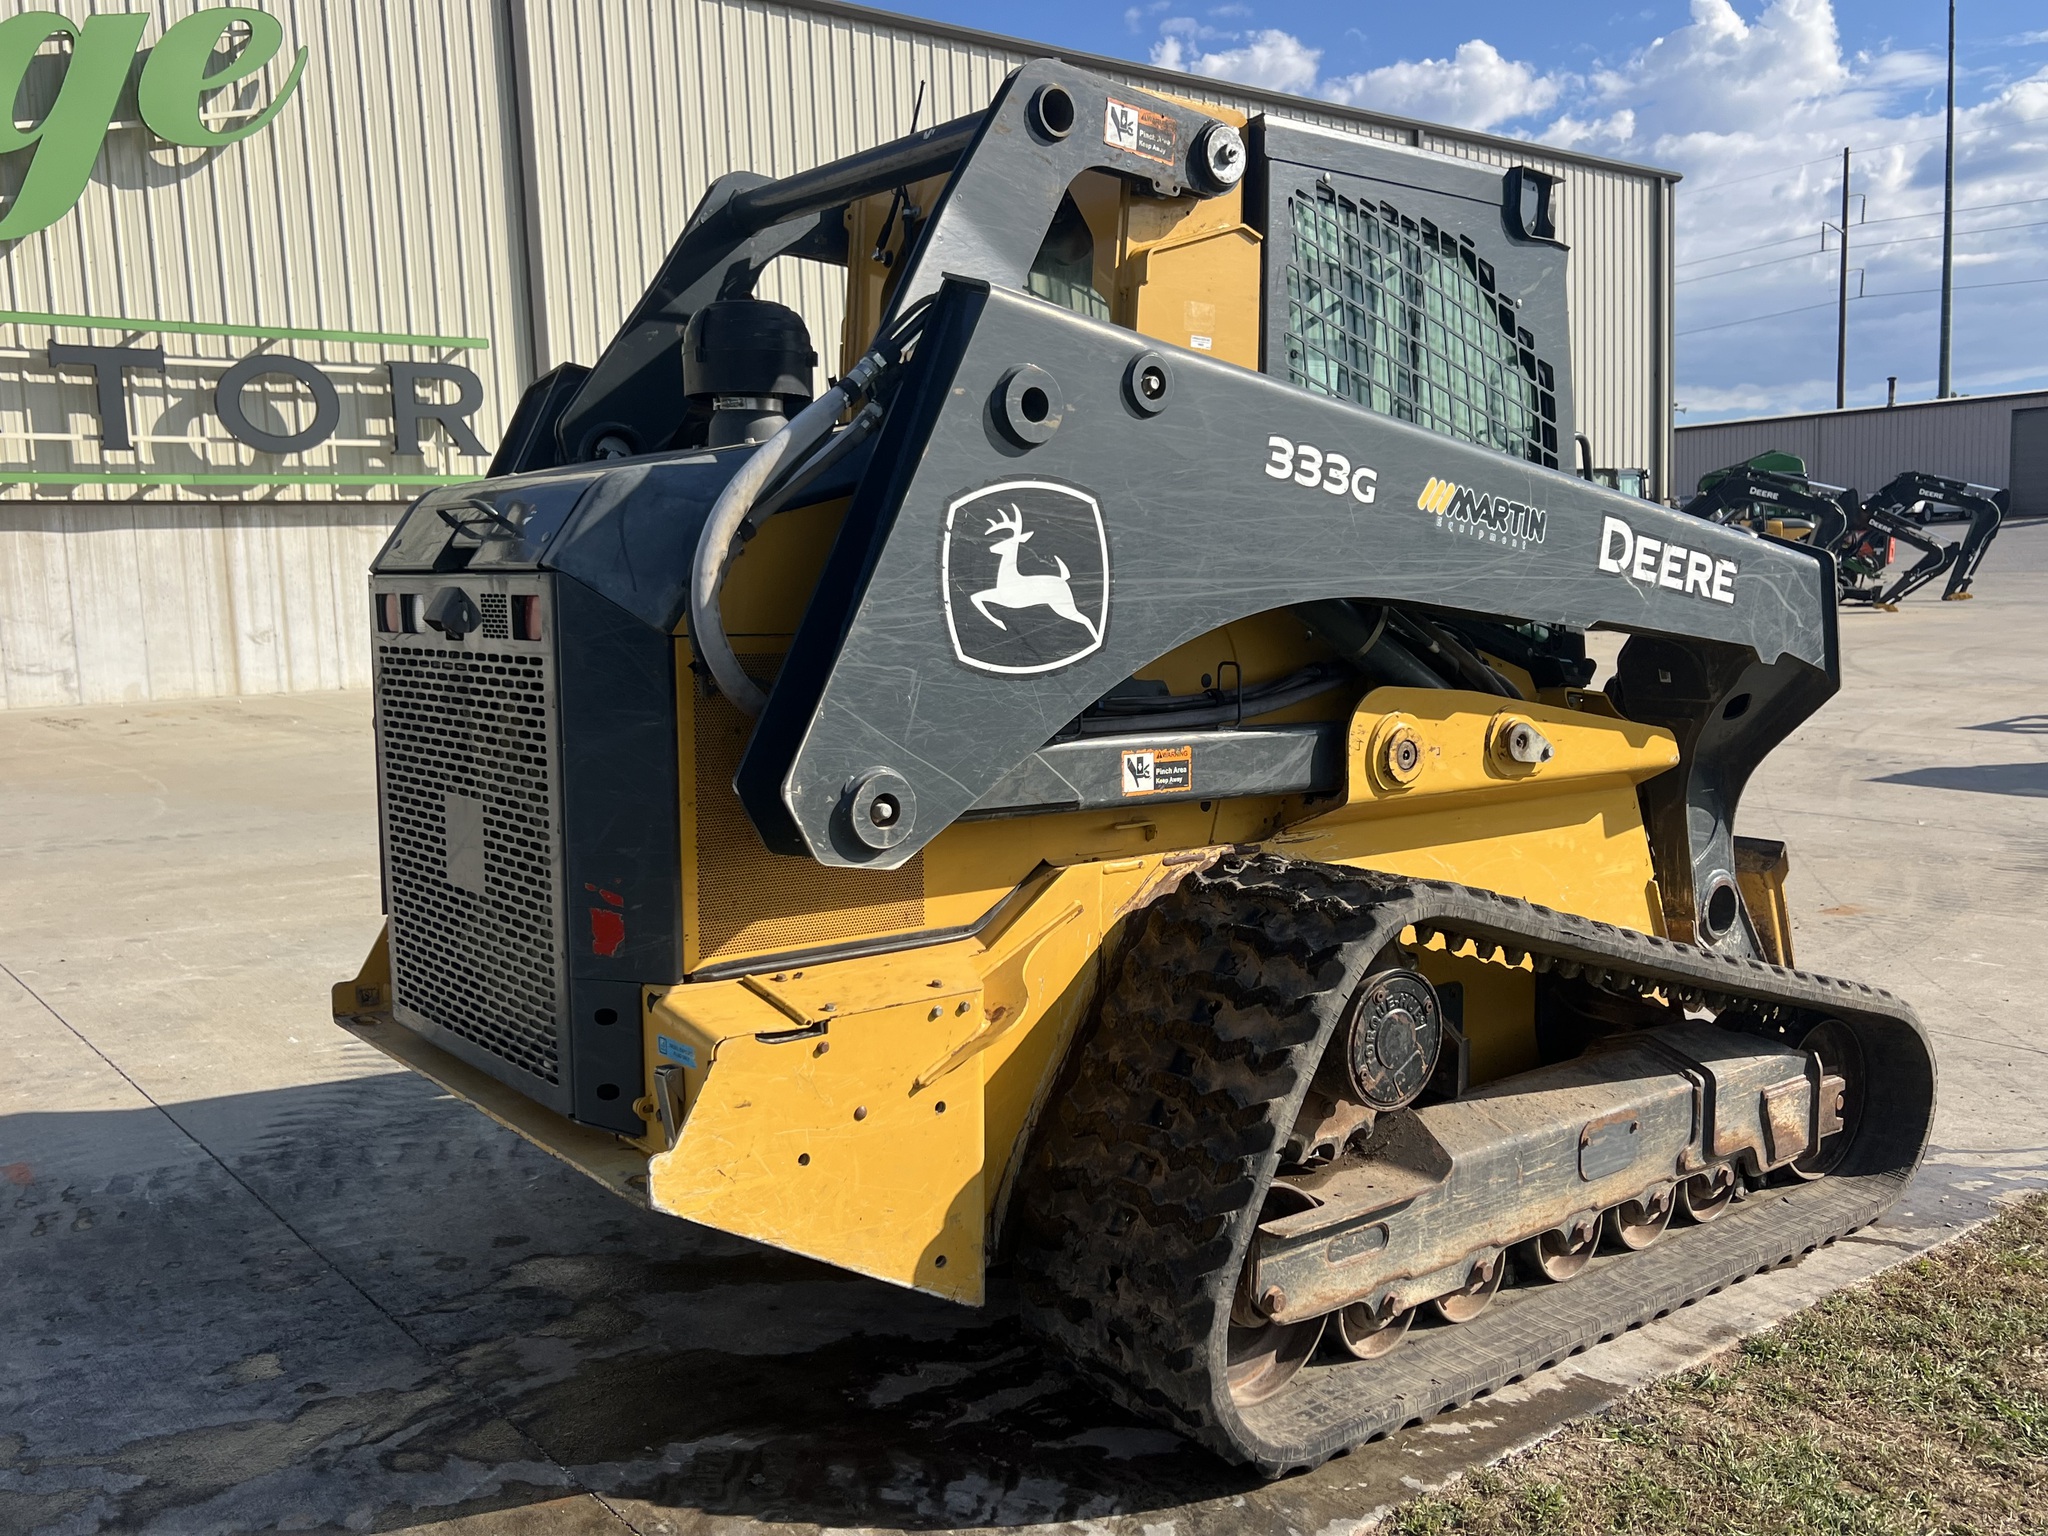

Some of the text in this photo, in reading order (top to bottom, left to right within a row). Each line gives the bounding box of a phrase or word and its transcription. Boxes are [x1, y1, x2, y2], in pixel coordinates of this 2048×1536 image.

[48, 338, 491, 457] TOR
[1264, 435, 1379, 504] 333G
[1749, 486, 1779, 500] DEERE
[1918, 488, 1944, 500] DEERE
[1446, 485, 1547, 543] MARTIN
[1868, 518, 1893, 534] DEERE
[1436, 516, 1526, 550] Equipment
[1599, 516, 1738, 604] DEERE
[1155, 766, 1187, 776] Pinch Area
[1155, 776, 1183, 786] Keep Away
